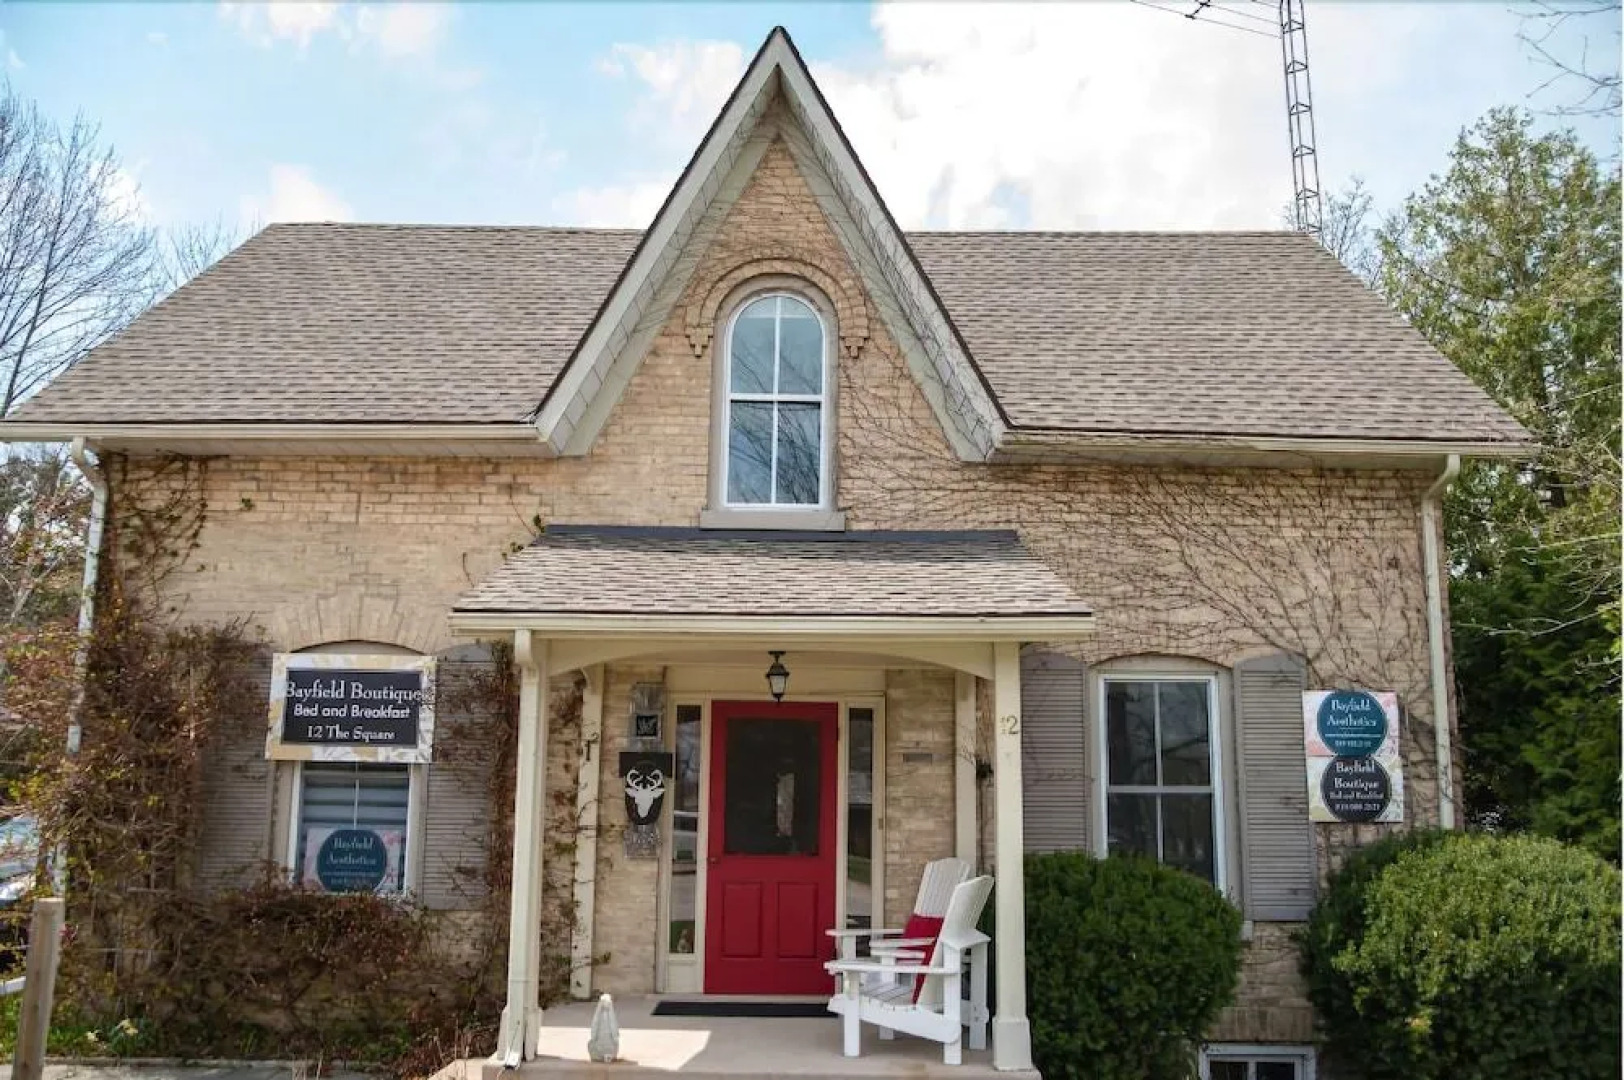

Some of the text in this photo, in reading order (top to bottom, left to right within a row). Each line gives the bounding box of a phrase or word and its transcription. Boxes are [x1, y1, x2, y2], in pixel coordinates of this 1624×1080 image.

[286, 679, 422, 704] Bayfield Boutique
[293, 704, 411, 719] Bed and Breakfast
[307, 724, 396, 742] 12 The Square
